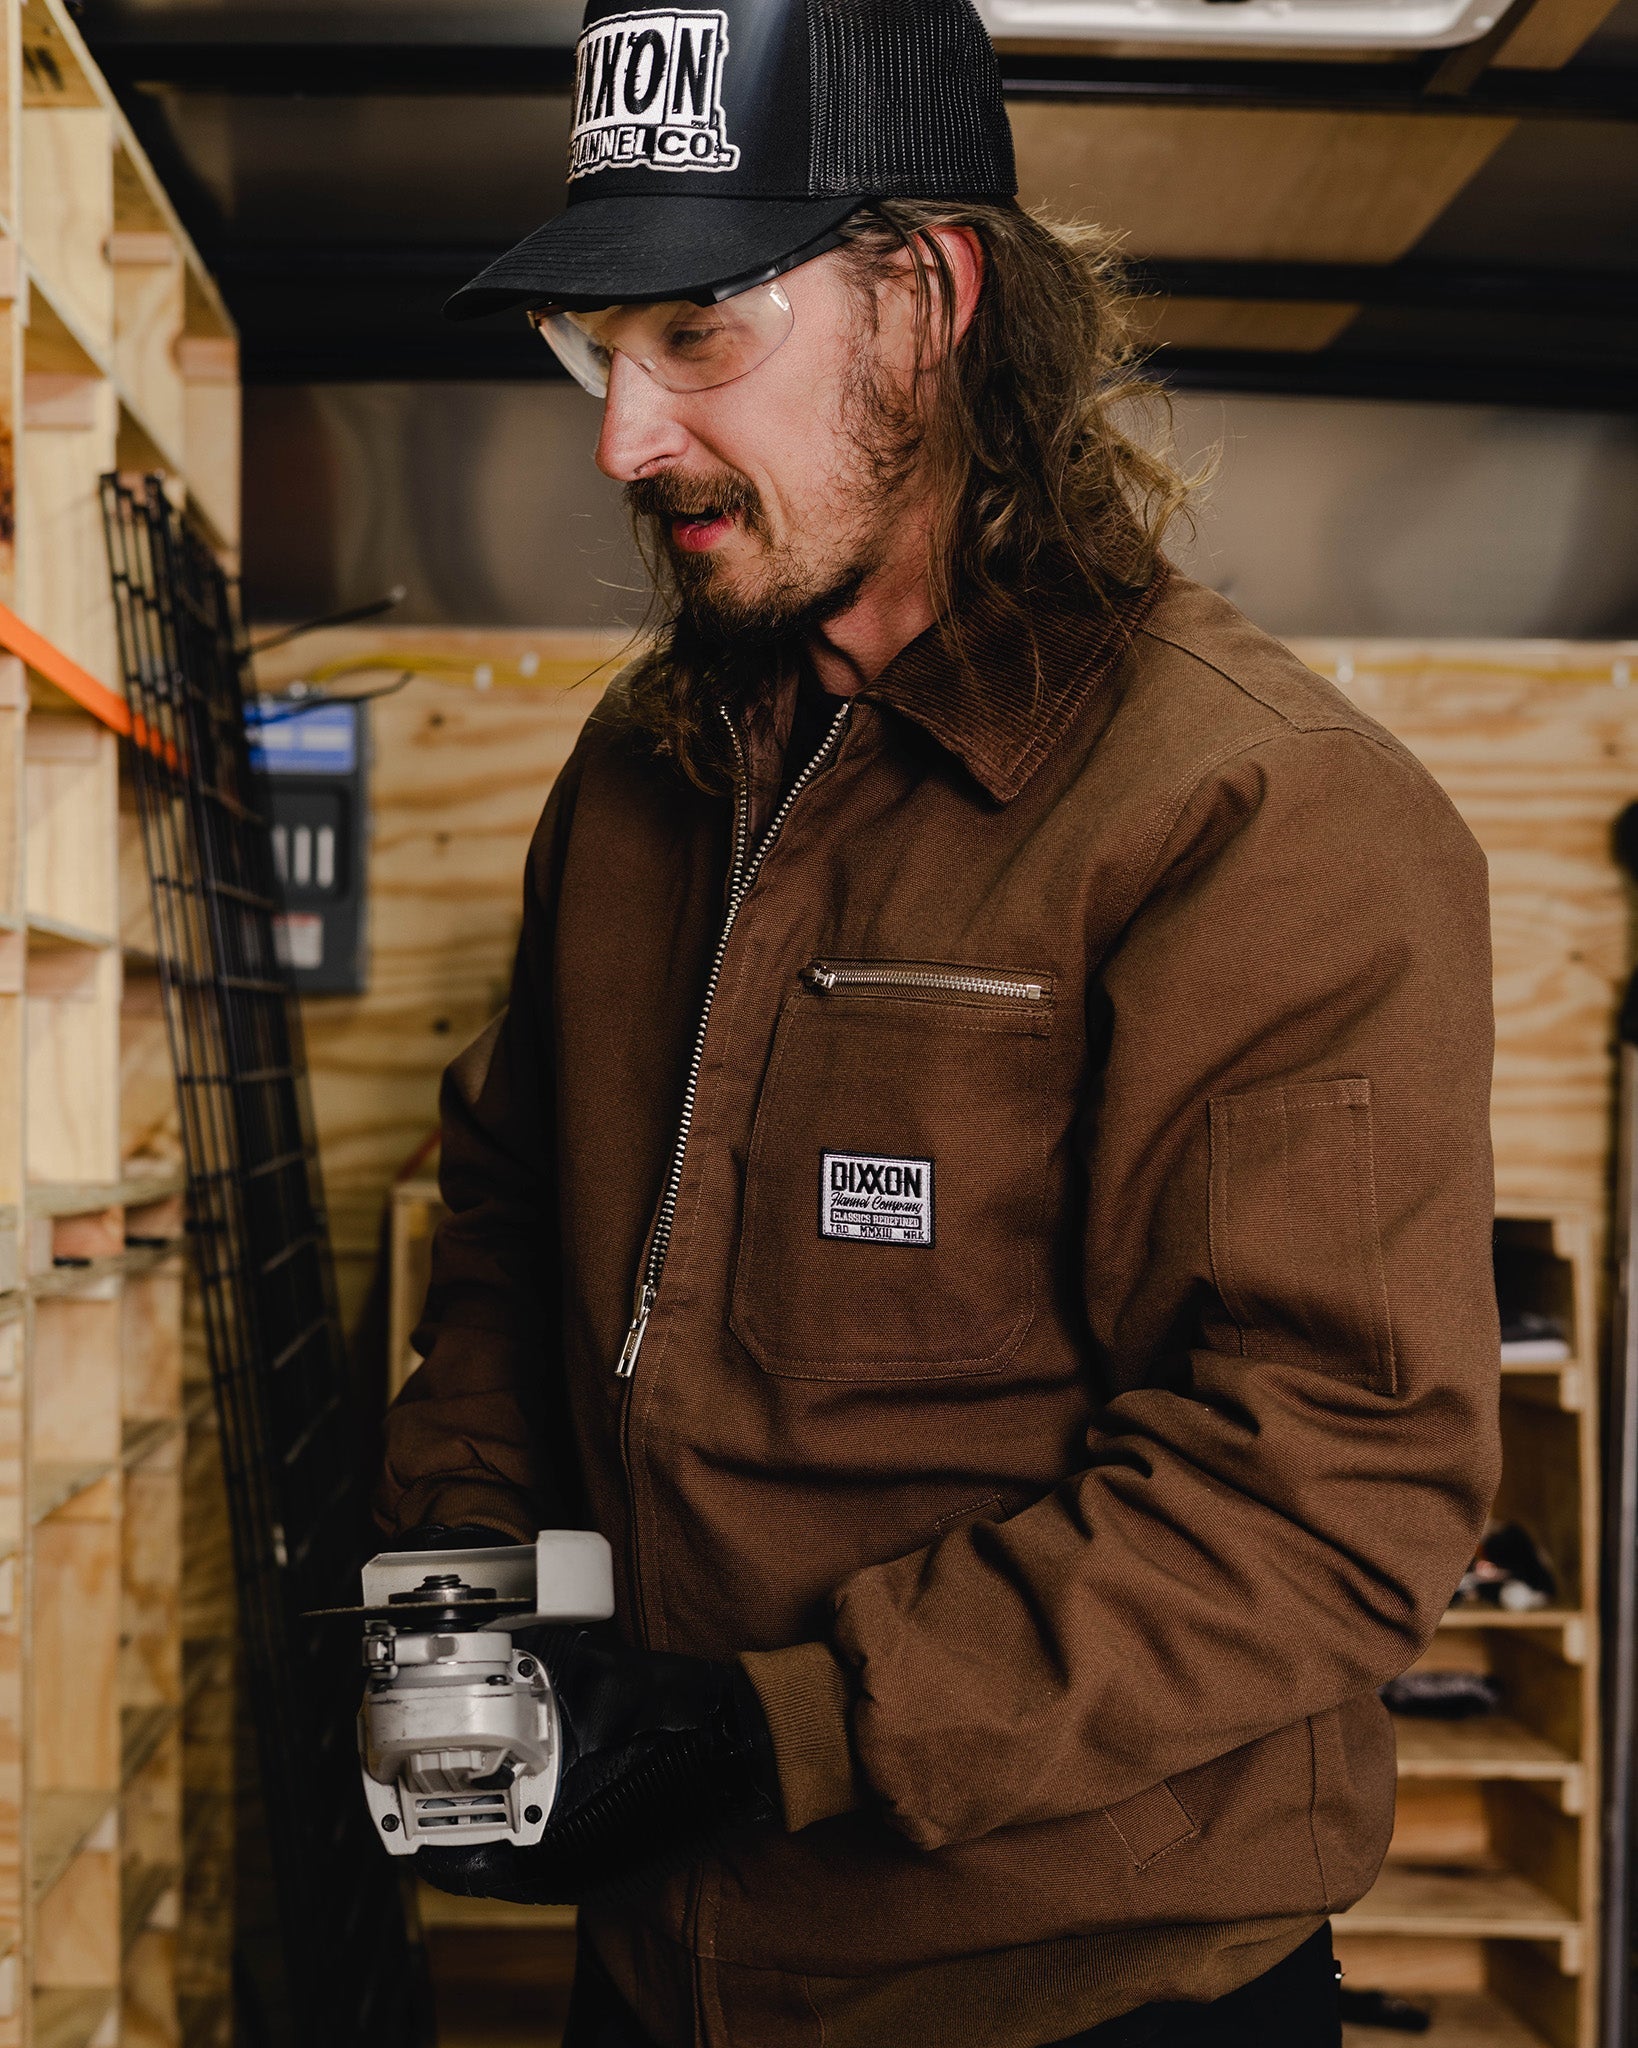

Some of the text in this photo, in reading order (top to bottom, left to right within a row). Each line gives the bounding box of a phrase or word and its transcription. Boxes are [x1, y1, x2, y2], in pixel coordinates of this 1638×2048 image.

[575, 28, 715, 127] IXXON
[831, 1161, 922, 1198] DIXXON
[830, 1192, 923, 1214] Flannel Company
[833, 1211, 919, 1227] CLASSICS REDEFINED
[830, 1224, 924, 1239] TRD MMXIII MRK
